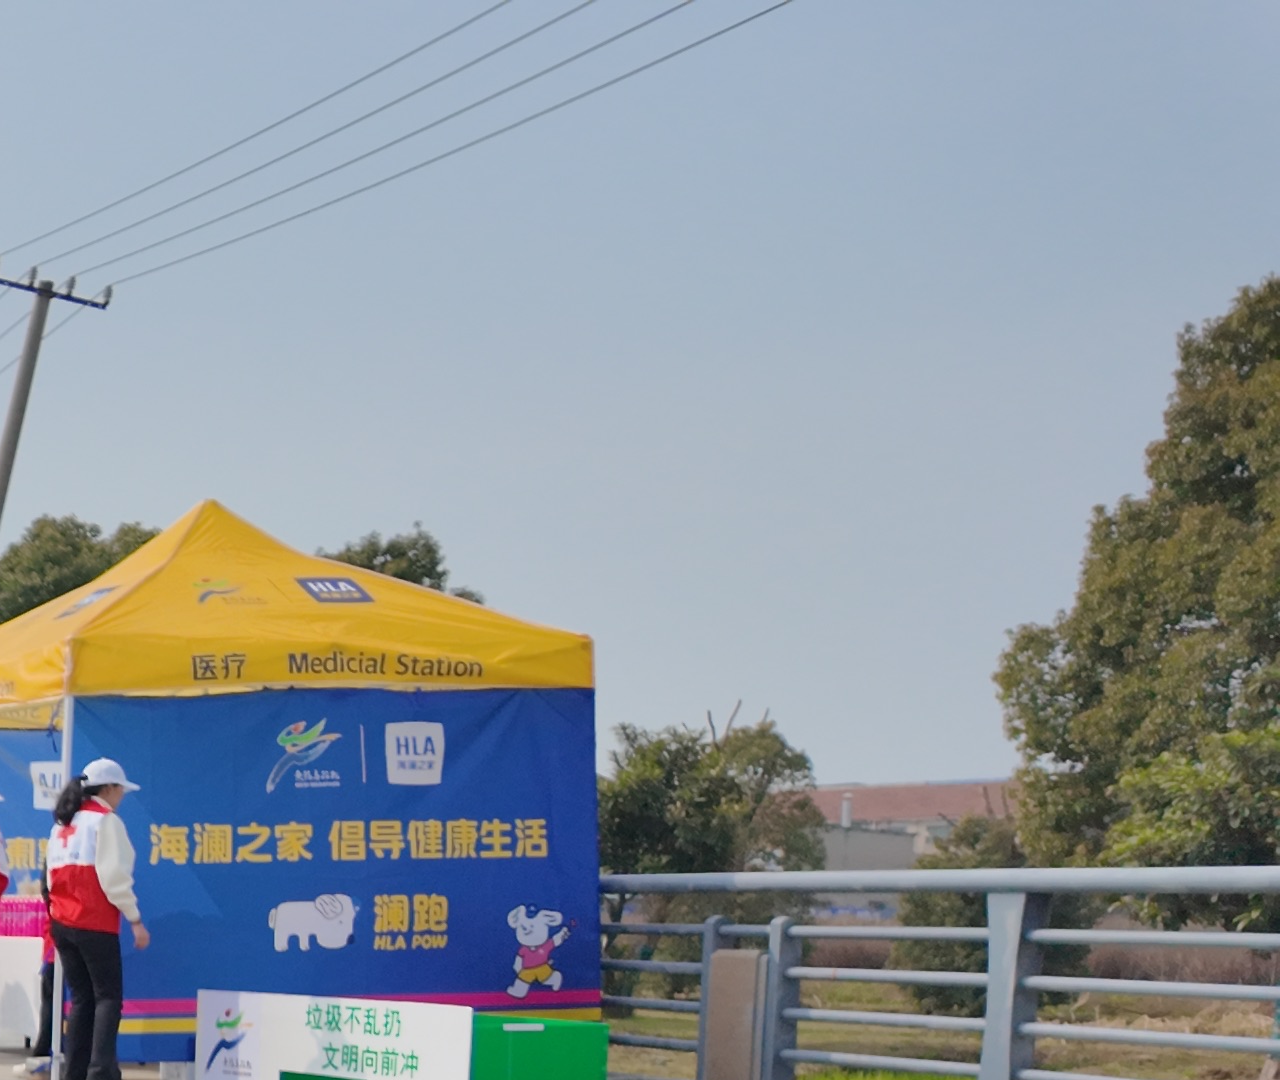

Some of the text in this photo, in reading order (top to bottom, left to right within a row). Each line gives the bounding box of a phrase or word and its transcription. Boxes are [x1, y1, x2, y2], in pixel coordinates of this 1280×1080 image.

[306, 581, 357, 593] HLA
[192, 653, 246, 681] 医疗
[288, 651, 483, 678] Medicial Station
[395, 736, 436, 757] HLA
[149, 818, 548, 866] 海澜之家 倡导健康生活
[373, 893, 449, 934] 澜跑
[373, 933, 449, 951] HLA POW
[305, 1003, 402, 1038] 垃圾不乱扔
[322, 1042, 419, 1079] 文明向前冲
